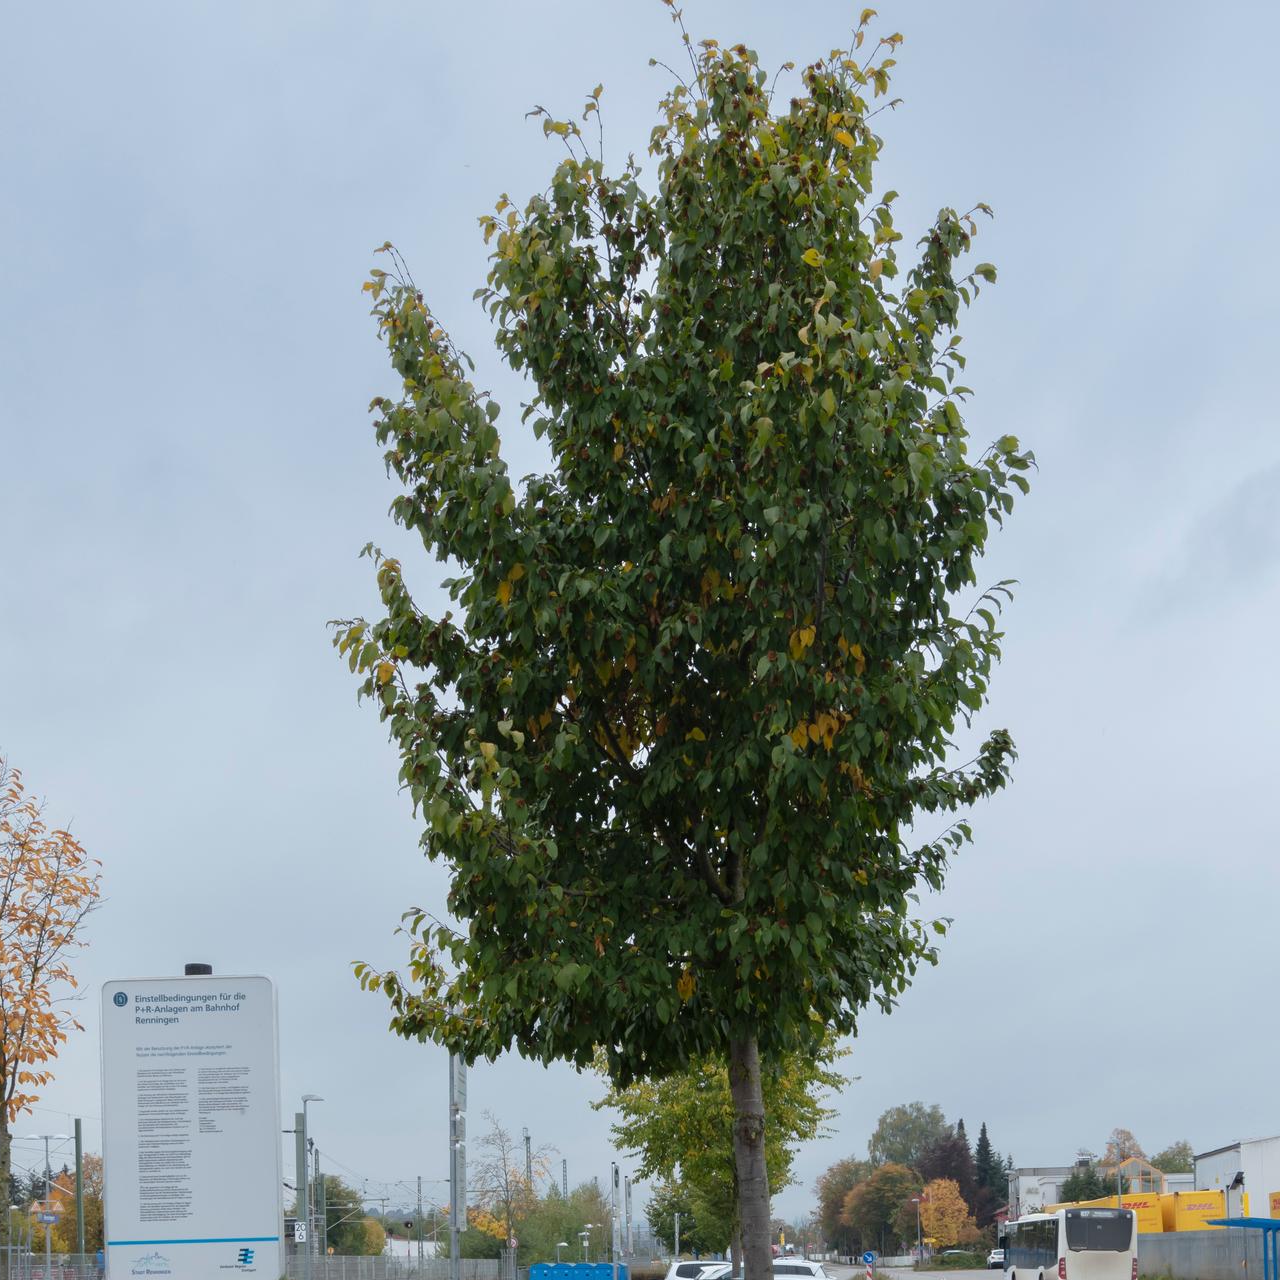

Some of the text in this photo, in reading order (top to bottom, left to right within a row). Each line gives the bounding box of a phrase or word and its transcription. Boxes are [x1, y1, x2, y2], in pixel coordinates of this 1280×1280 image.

[135, 992, 246, 1003] Einstellbedingungen für die
[135, 1004, 188, 1014] P+R-Anlagen
[205, 1003, 240, 1012] Bahnhof
[135, 1016, 179, 1026] Renningen
[295, 1223, 306, 1231] 20
[298, 1232, 304, 1240] 6
